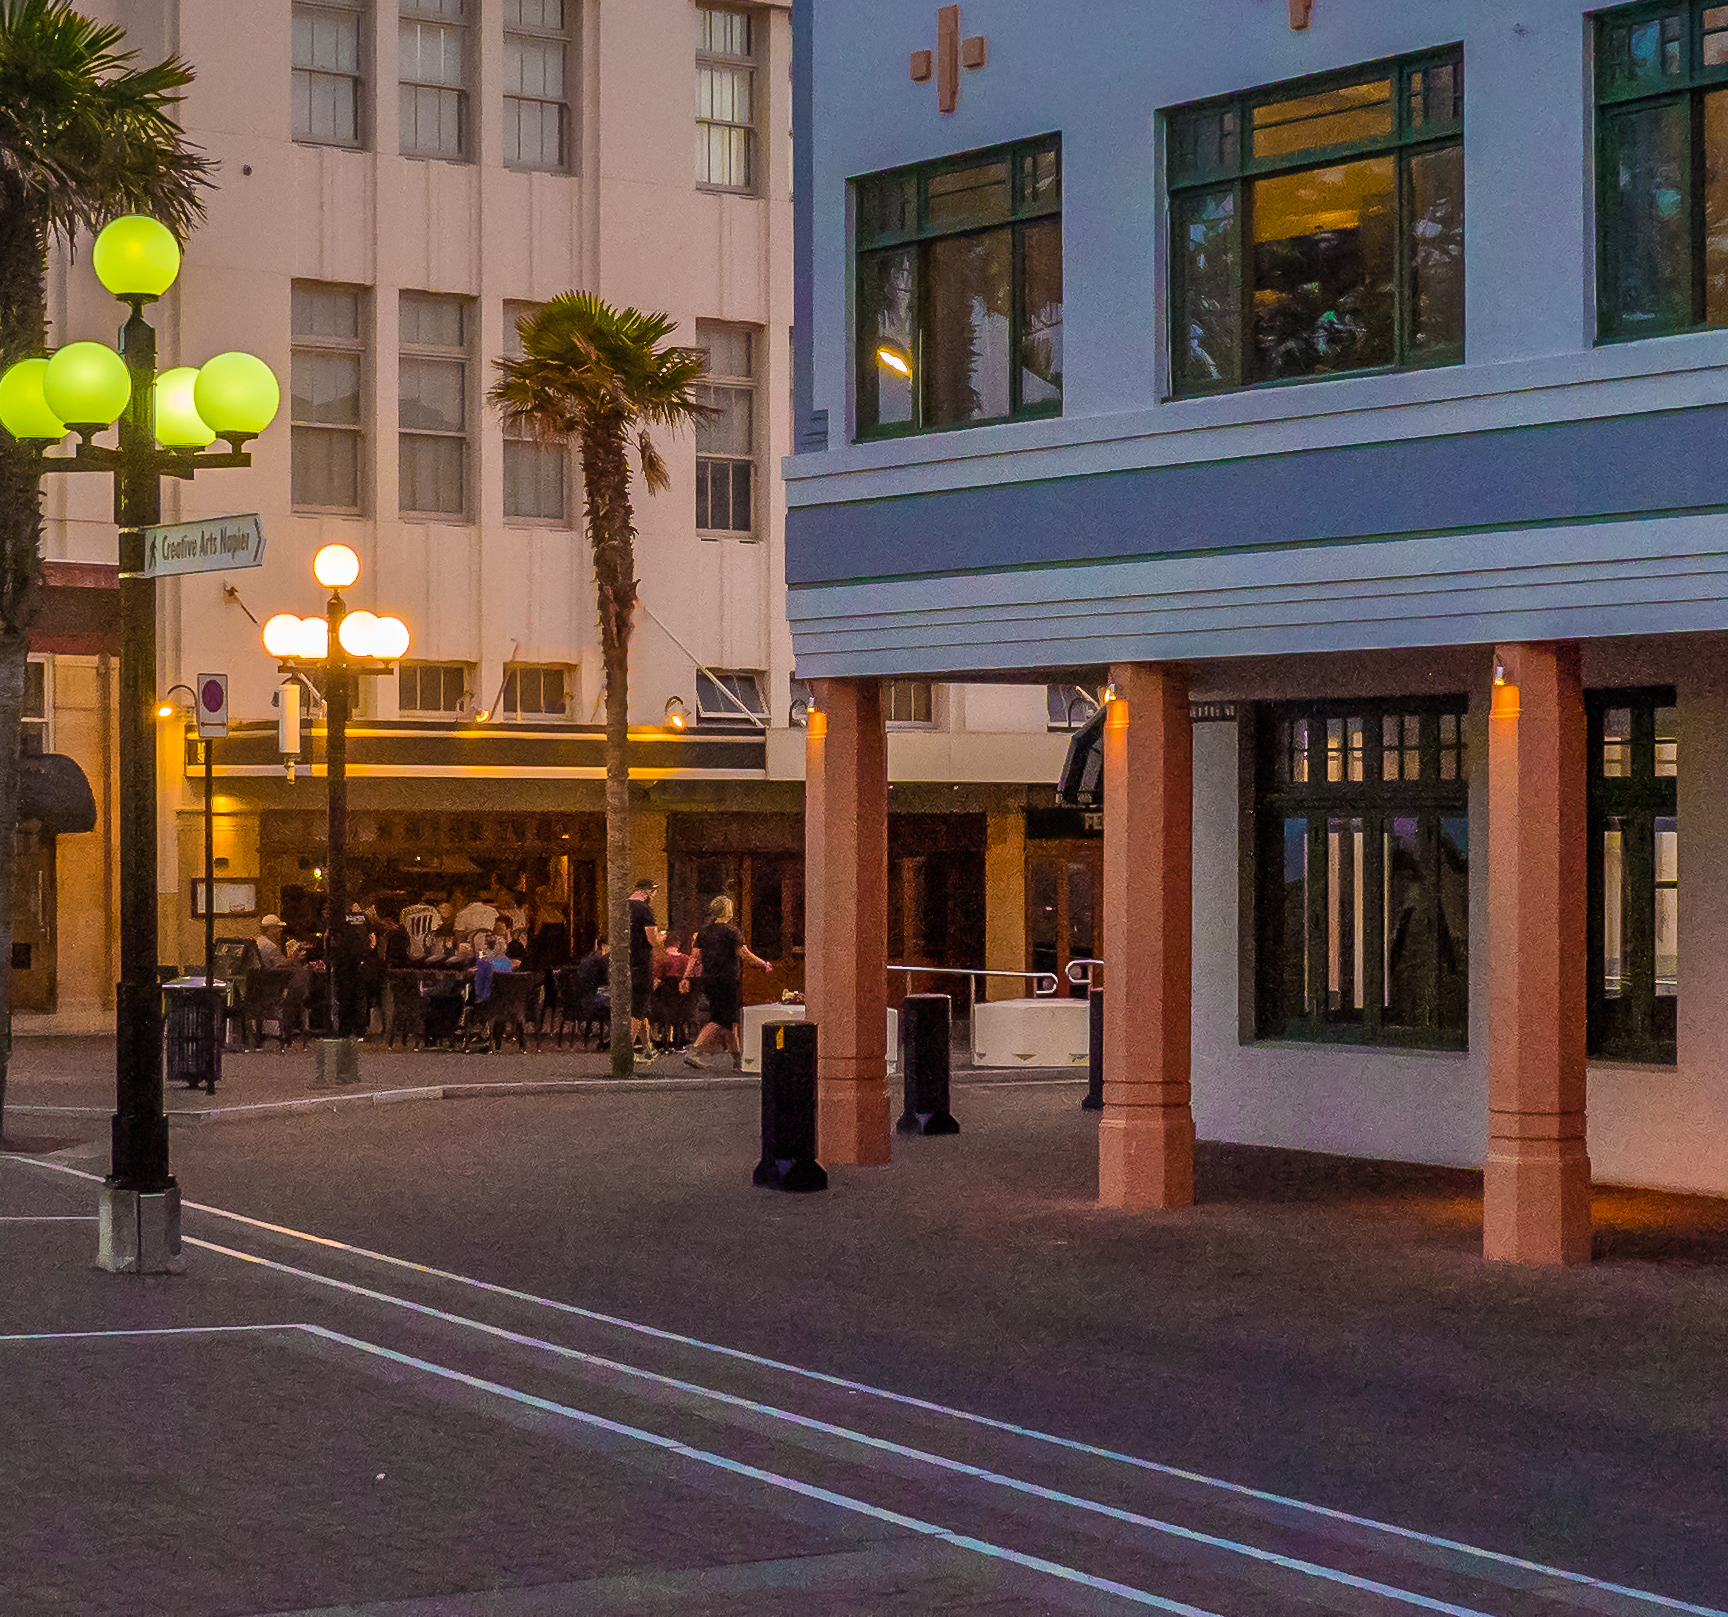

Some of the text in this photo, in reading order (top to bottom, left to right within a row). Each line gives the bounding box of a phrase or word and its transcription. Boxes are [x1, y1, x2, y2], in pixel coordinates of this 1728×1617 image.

[161, 527, 250, 560] Creative Arts Napier
